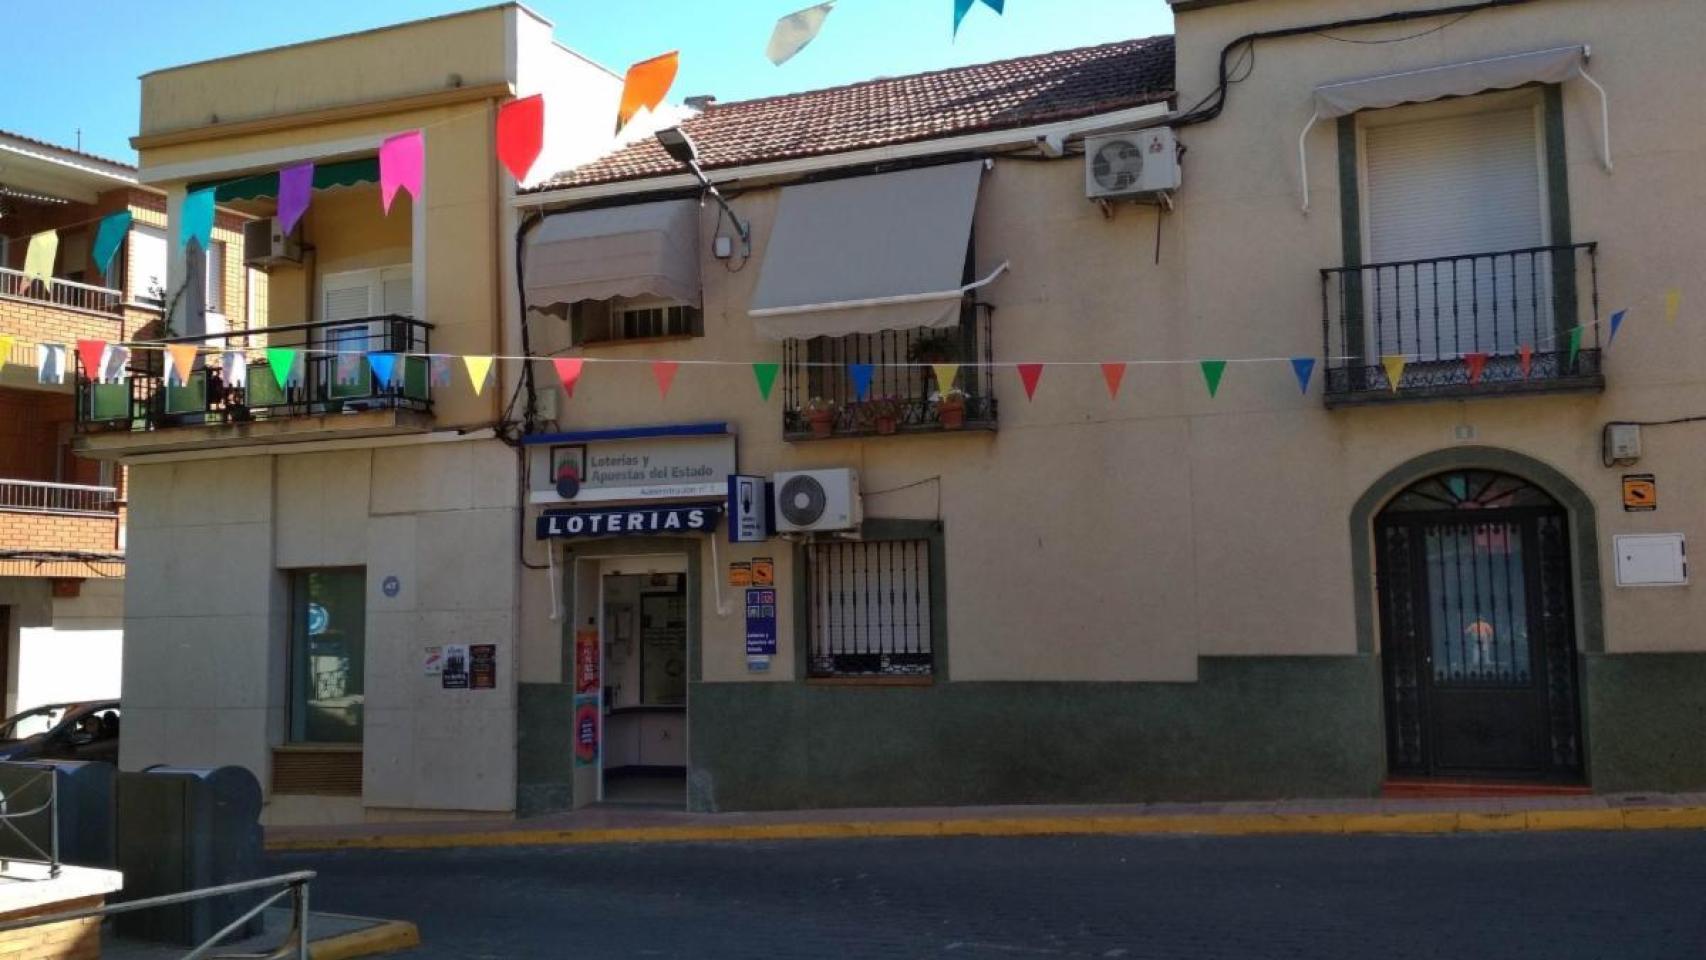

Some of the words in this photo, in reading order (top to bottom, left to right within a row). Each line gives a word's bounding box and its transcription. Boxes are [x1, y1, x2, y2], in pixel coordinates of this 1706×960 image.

[643, 456, 649, 468] y
[592, 470, 645, 484] Apuestas
[649, 466, 668, 478] del
[672, 465, 713, 477] Estado
[548, 510, 705, 535] LOTERIAS
